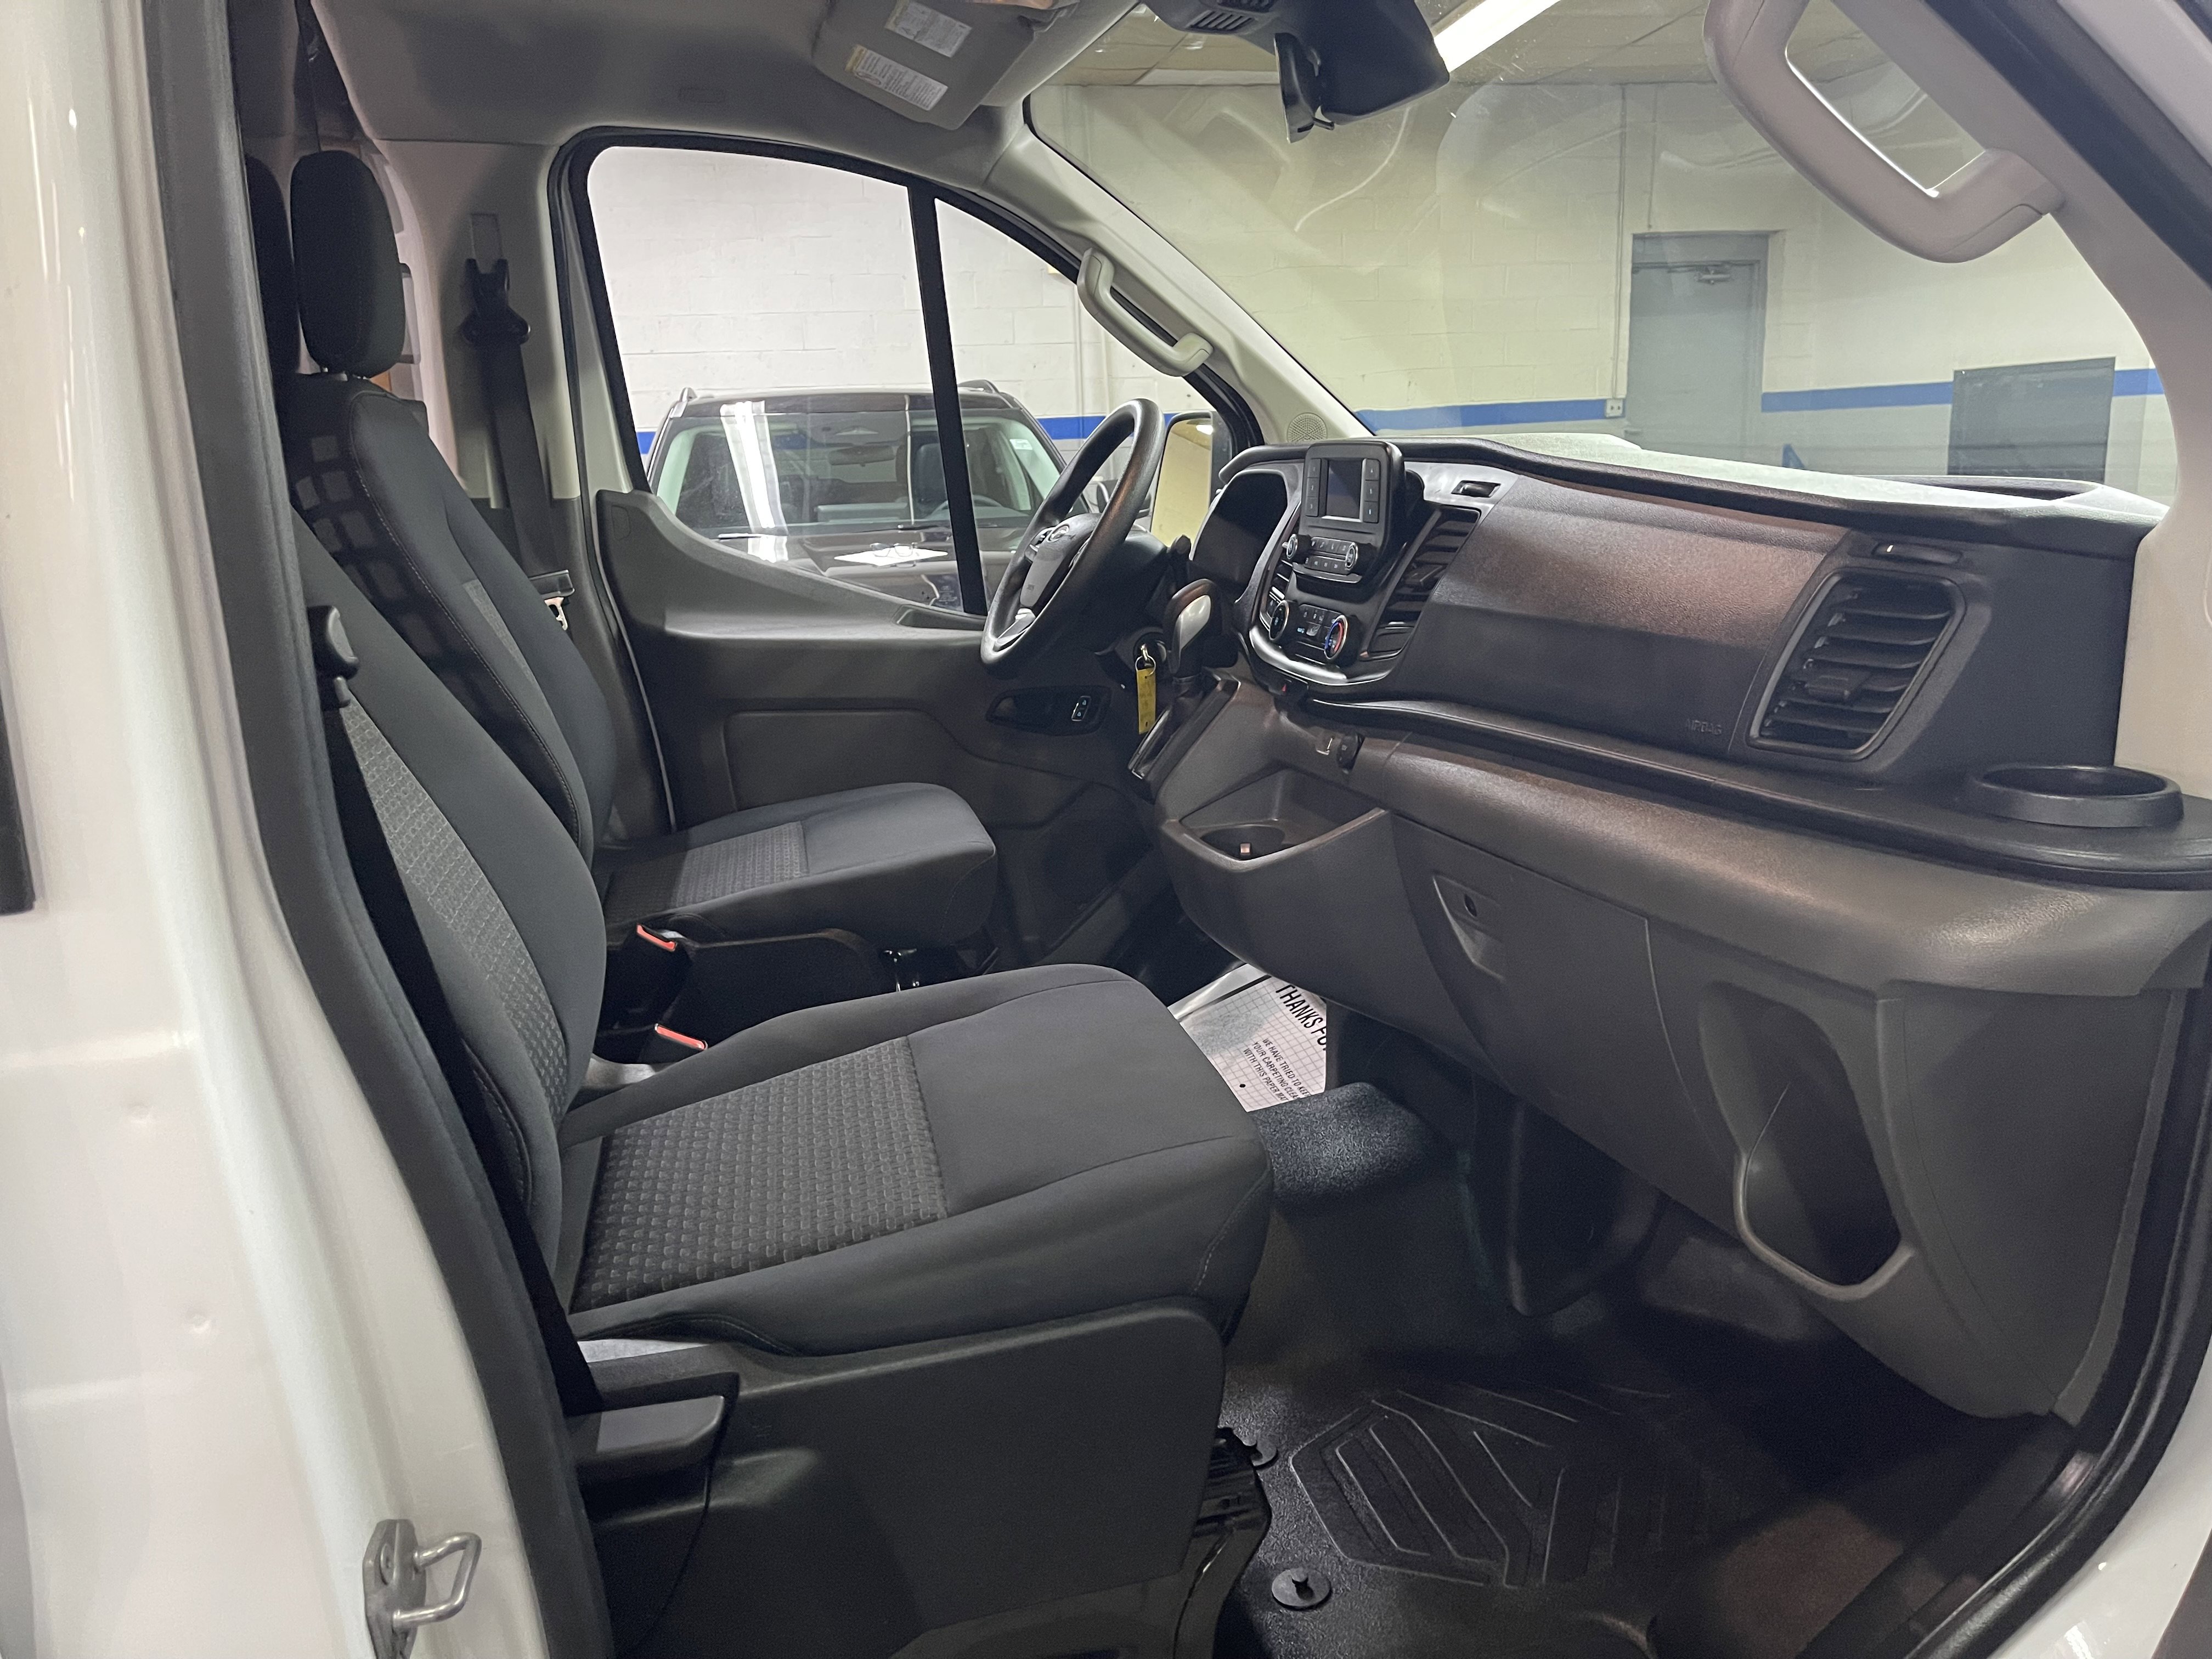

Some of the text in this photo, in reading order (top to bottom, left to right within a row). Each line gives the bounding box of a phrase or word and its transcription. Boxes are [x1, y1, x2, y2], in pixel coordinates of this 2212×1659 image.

[1685, 718, 1722, 736] AIRBAG
[1276, 985, 1323, 1029] THANKS
[1243, 1048, 1289, 1102] WITH THIS PAPER MAT
[1251, 1042, 1267, 1057] YOUR
[1262, 1056, 1289, 1087] CARPETING
[1262, 1037, 1272, 1047] WE
[1268, 1046, 1283, 1062] HAVE
[1279, 1060, 1295, 1079] TRIED
